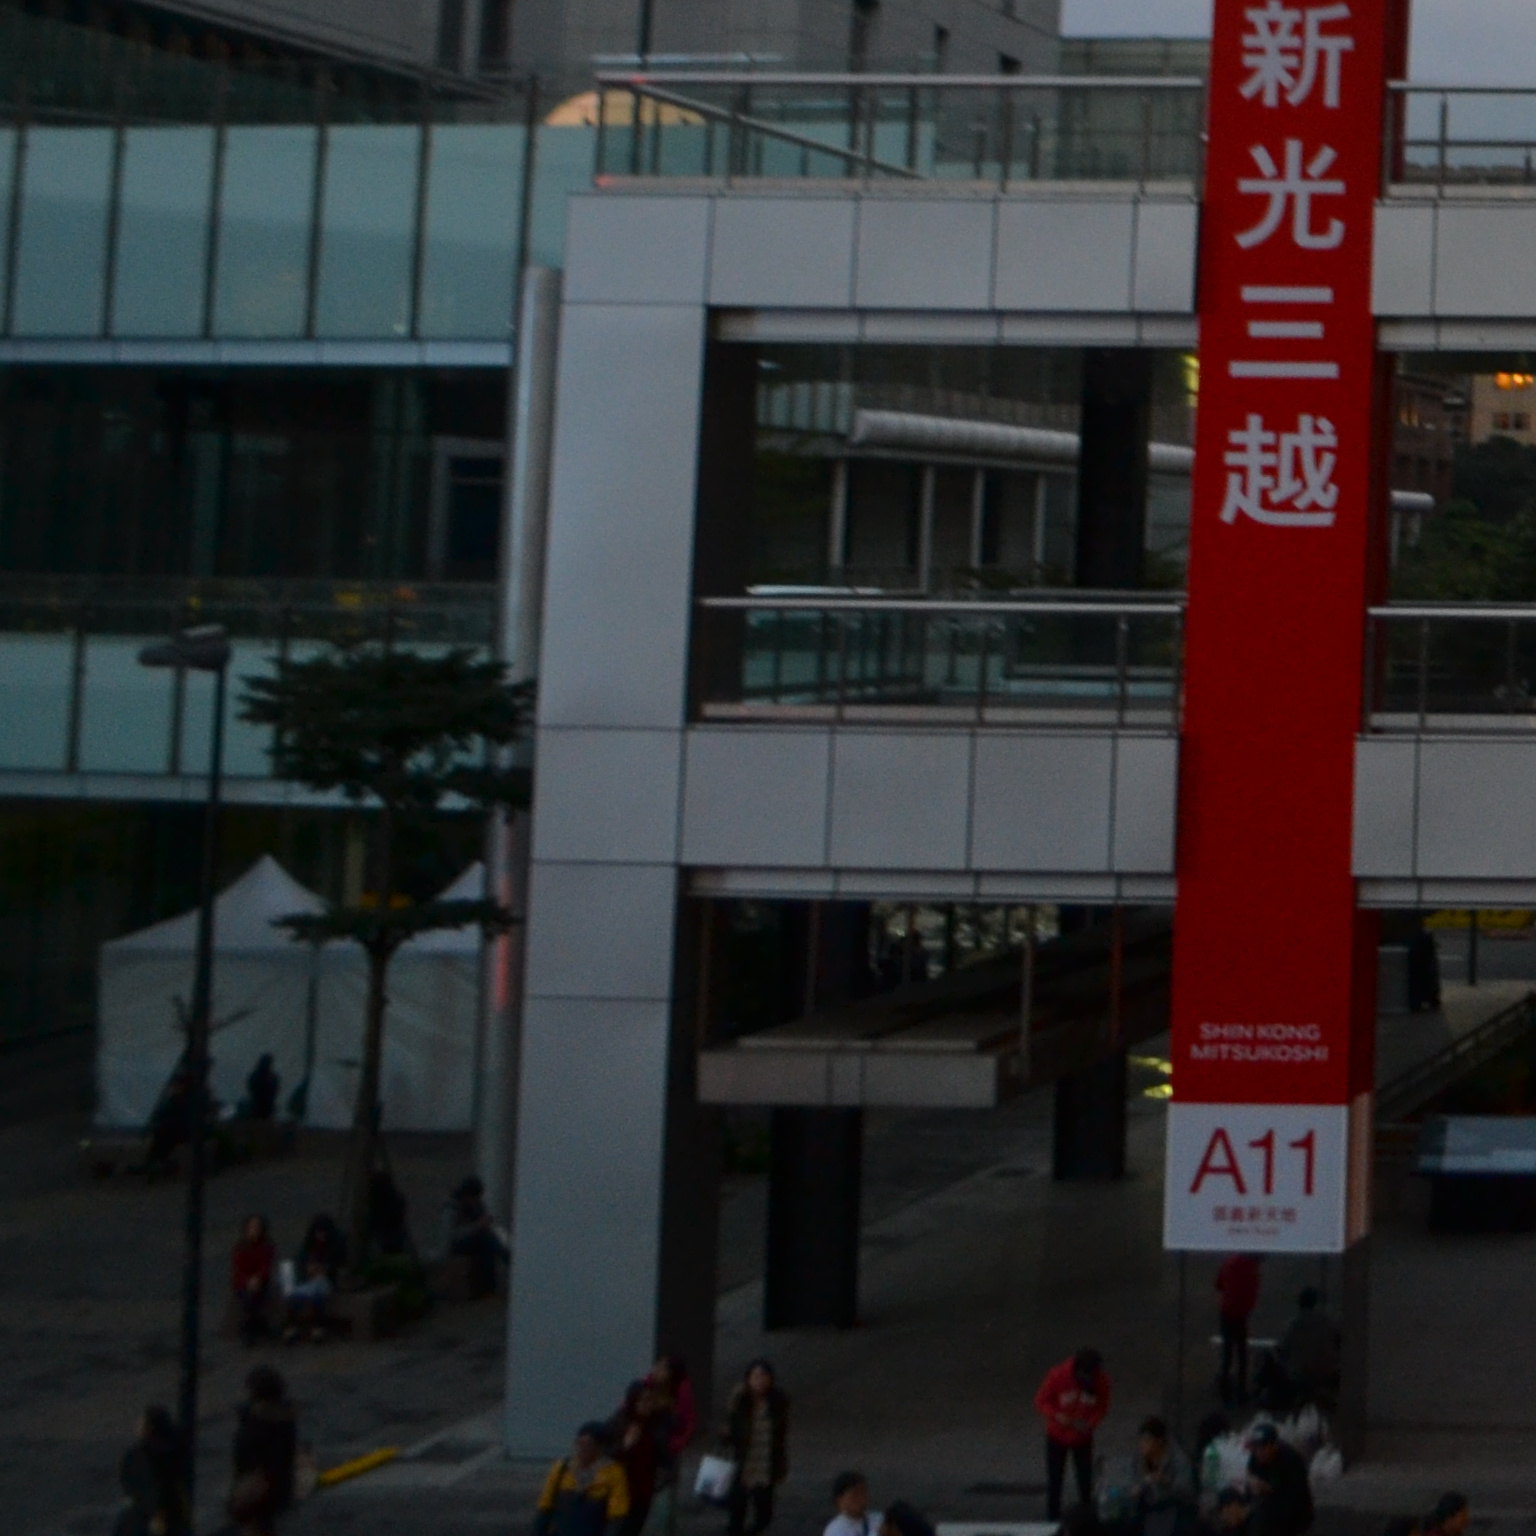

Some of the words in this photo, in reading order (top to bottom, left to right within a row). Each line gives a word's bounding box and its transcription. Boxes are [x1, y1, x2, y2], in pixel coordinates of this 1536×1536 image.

[1199, 1022, 1254, 1040] SHIN
[1256, 1023, 1321, 1041] KONG
[1190, 1043, 1329, 1062] MITSUKOSHI
[1188, 1127, 1315, 1196] A11
